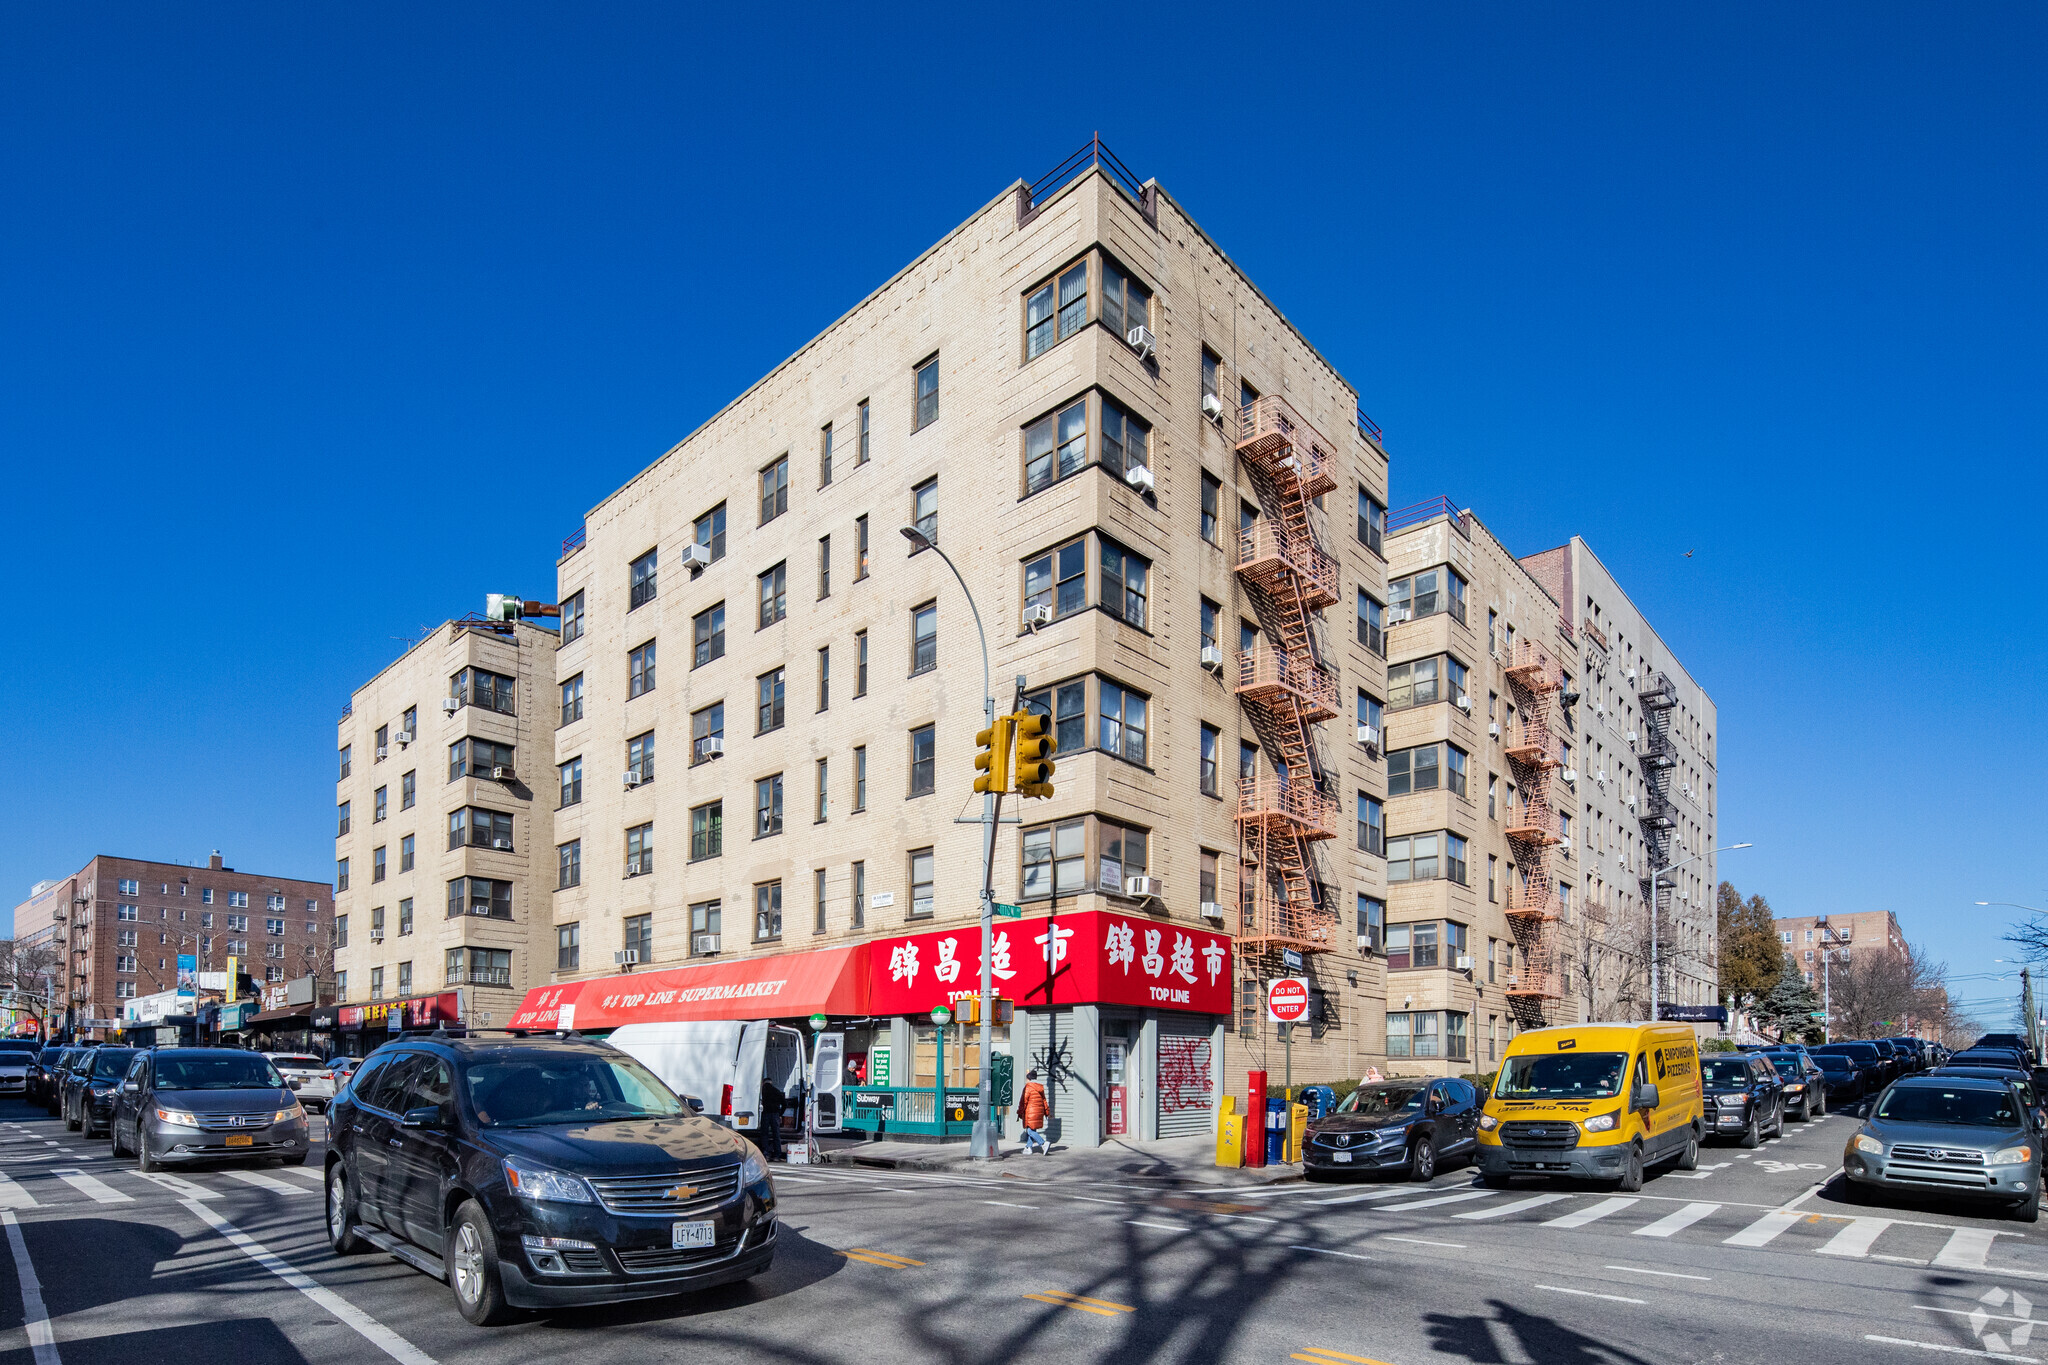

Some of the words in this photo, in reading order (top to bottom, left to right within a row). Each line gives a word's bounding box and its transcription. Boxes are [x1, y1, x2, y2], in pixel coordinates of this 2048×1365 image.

[1104, 920, 1226, 988] 錦昌超市
[620, 993, 645, 1008] TOP
[644, 990, 677, 1006] LINE
[678, 979, 788, 1004] SUPERMARKET
[1149, 986, 1170, 1001] TOP
[1170, 988, 1190, 1004] LINE
[1287, 986, 1301, 995] NOT
[1277, 1005, 1299, 1013] ENTER
[516, 1012, 537, 1025] TOP
[1664, 1045, 1695, 1061] EMPOWERING
[1666, 1061, 1691, 1078] PIZZERIAS
[856, 1093, 880, 1104] Subway
[957, 1110, 962, 1118] R
